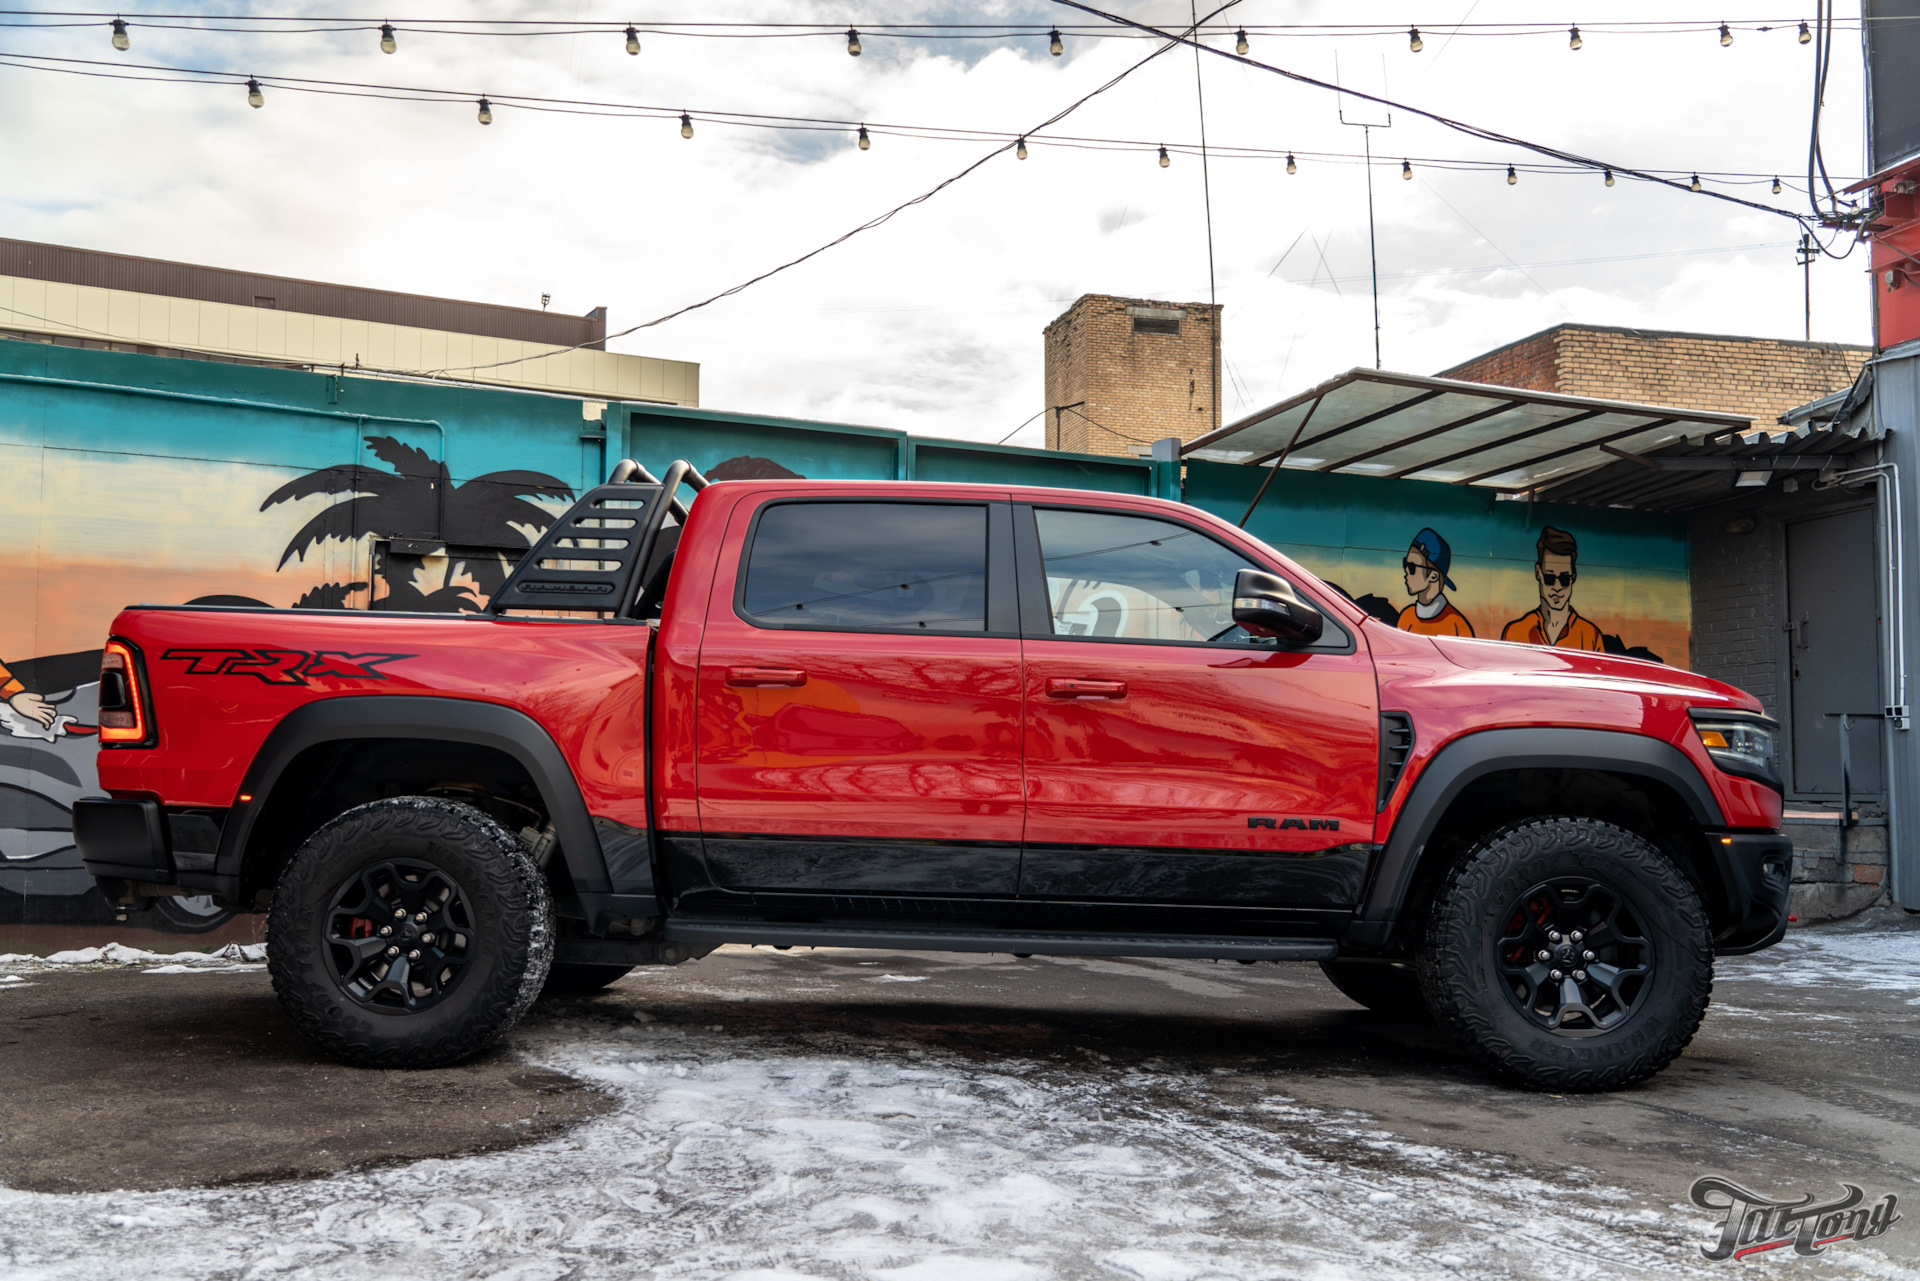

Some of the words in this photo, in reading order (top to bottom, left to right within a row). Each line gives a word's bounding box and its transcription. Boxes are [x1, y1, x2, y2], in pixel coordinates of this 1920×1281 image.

[521, 583, 608, 593] RAMBAR
[160, 648, 421, 686] TRX
[1247, 816, 1340, 831] RAM
[1529, 1014, 1665, 1062] WRANGLER
